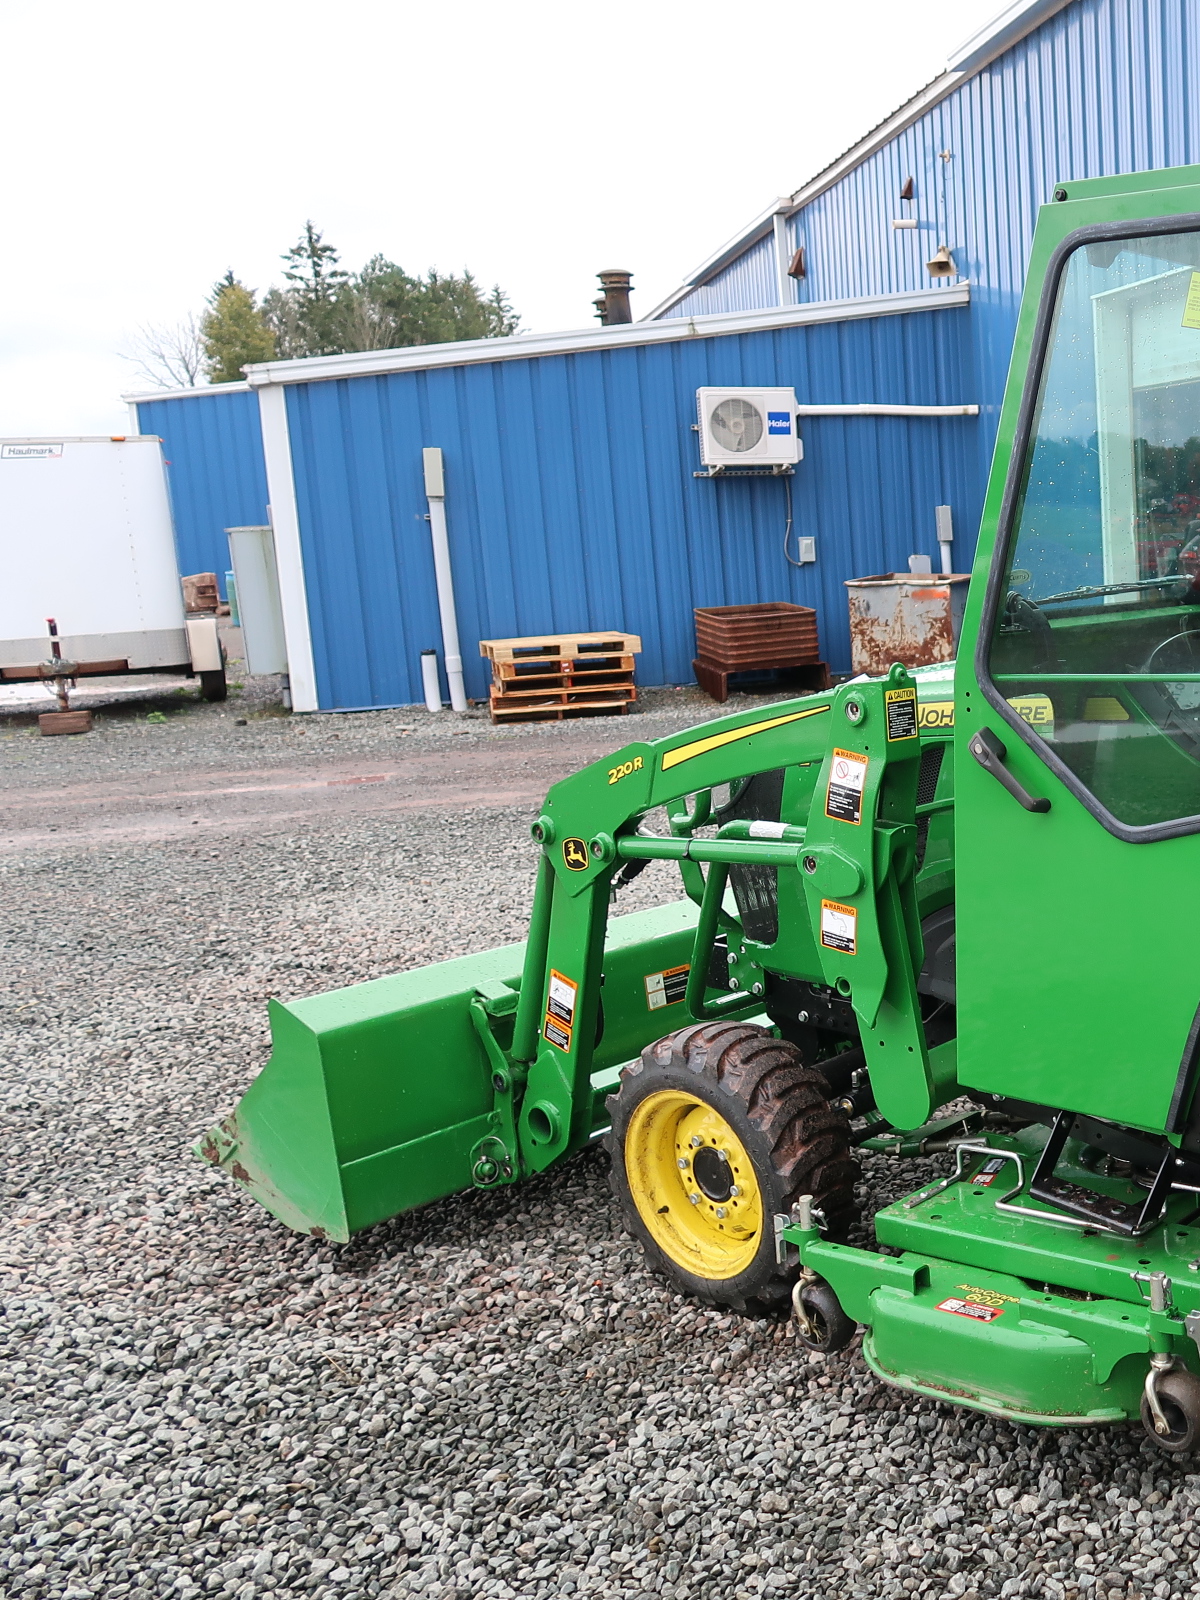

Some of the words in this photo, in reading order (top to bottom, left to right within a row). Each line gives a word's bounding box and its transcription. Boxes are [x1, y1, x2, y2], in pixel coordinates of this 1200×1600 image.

[768, 419, 790, 428] Haier
[8, 447, 53, 455] Haulmark
[893, 690, 914, 700] CAUTION
[918, 706, 954, 725] JOH
[840, 750, 867, 763] WARNING
[829, 903, 855, 916] WARNING
[955, 1284, 1021, 1304] AutoConne
[965, 1293, 1005, 1306] 60D
